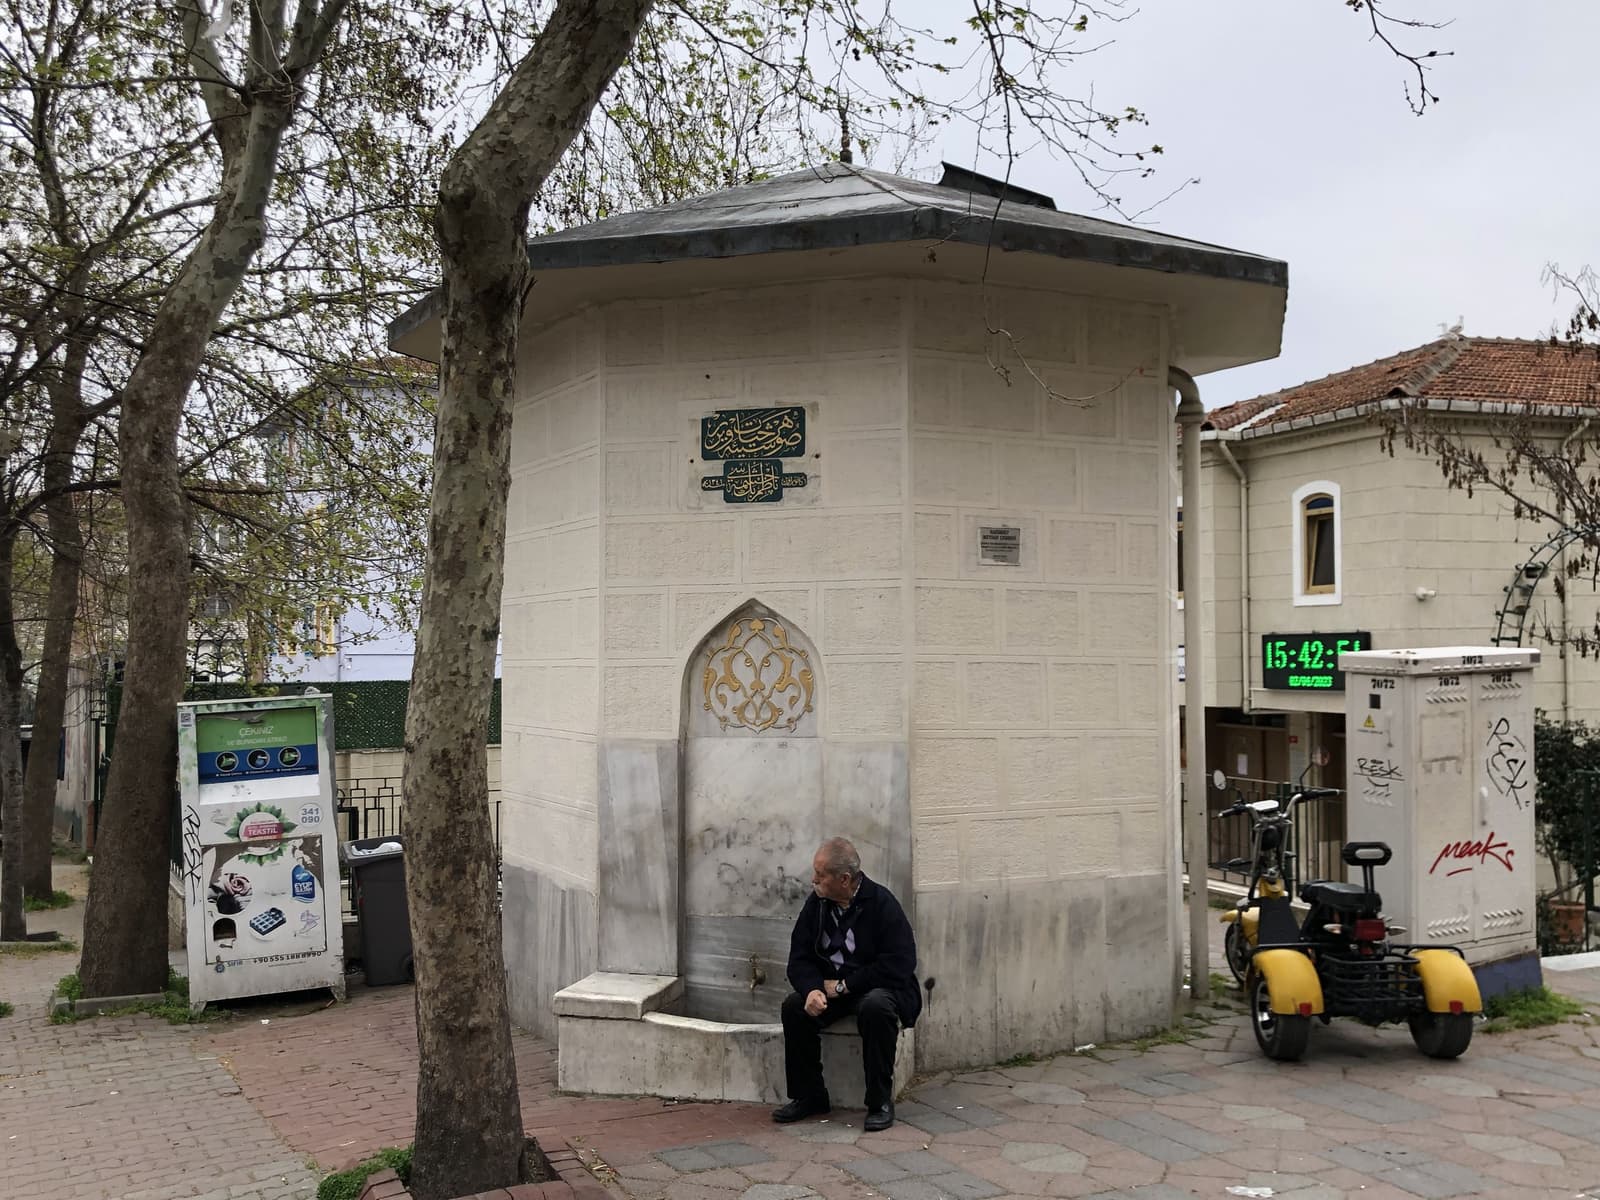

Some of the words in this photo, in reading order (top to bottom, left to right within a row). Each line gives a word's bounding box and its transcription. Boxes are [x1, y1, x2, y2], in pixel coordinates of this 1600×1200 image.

[1438, 676, 1461, 686] 7072
[1491, 672, 1513, 683] 7072
[1371, 678, 1396, 689] 7072
